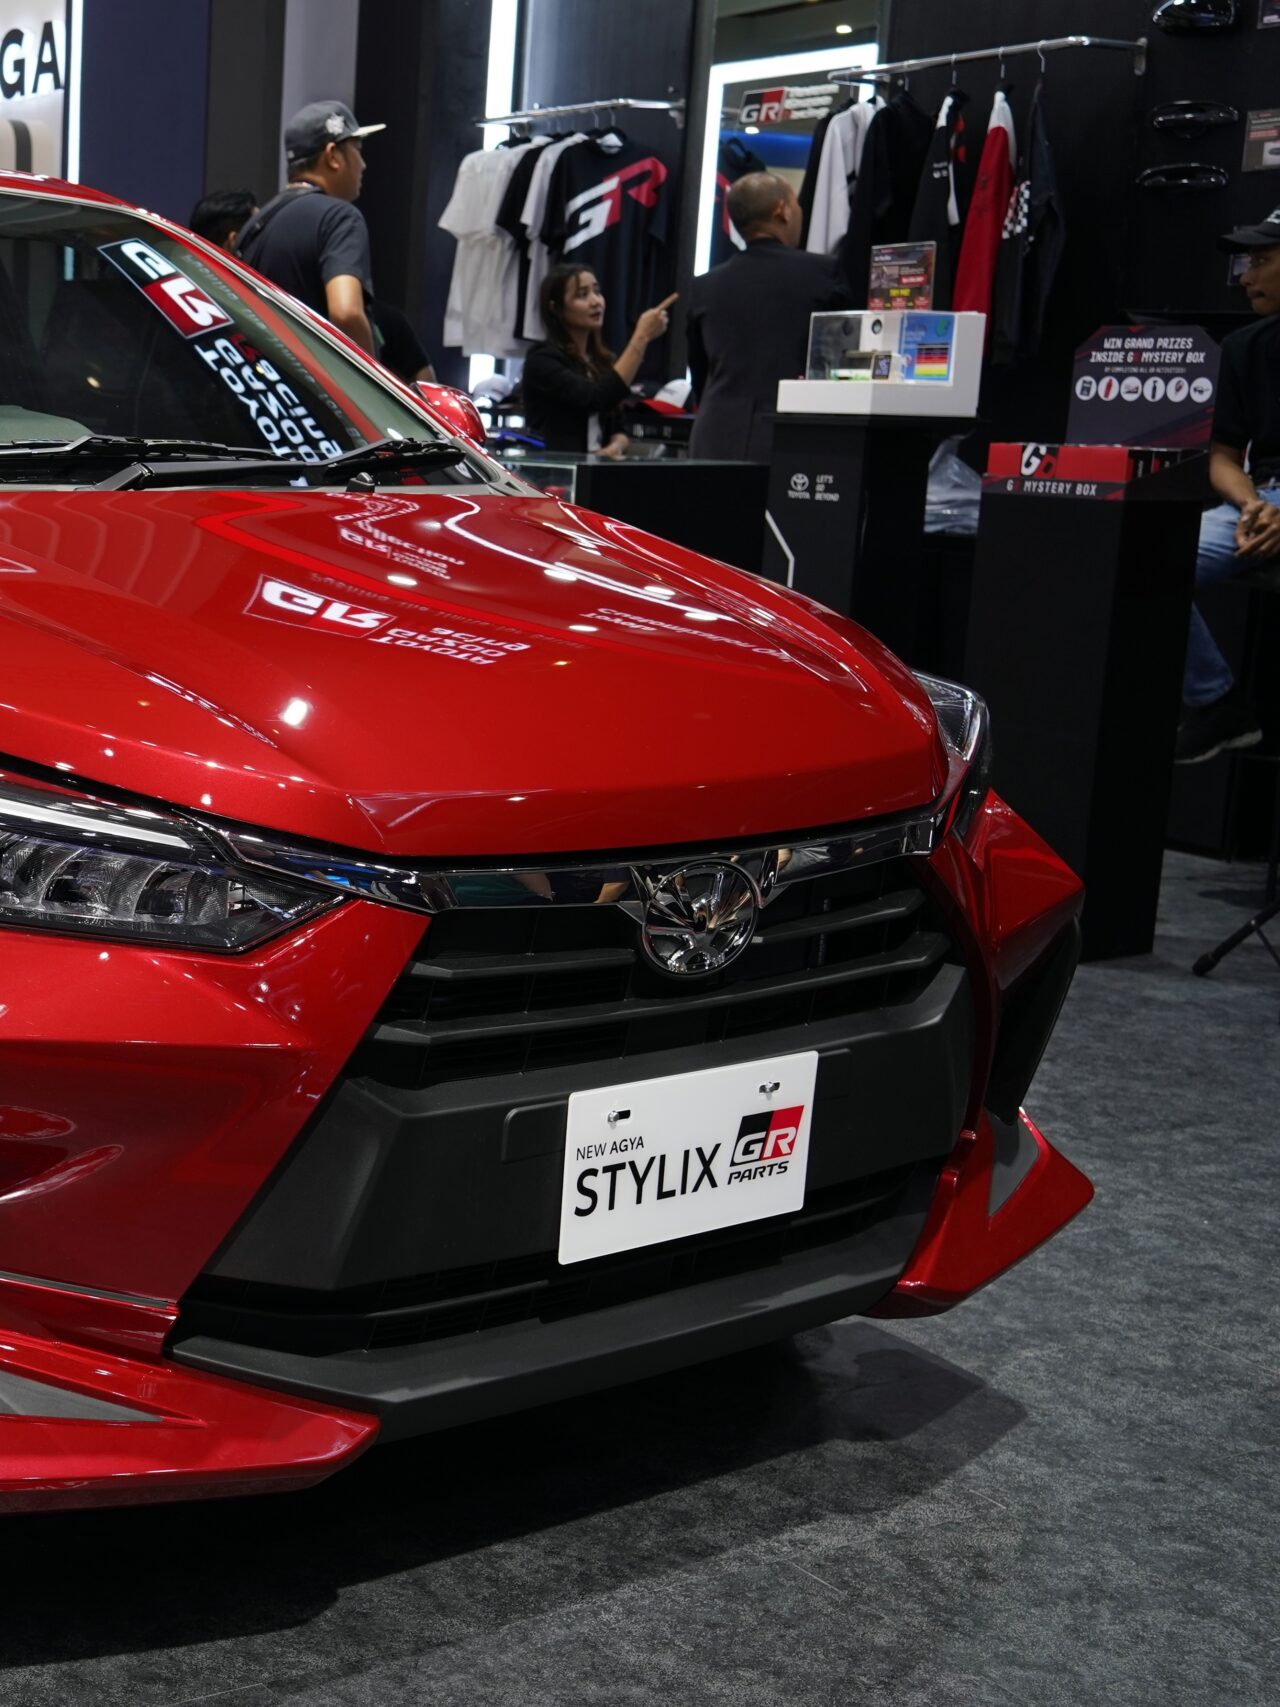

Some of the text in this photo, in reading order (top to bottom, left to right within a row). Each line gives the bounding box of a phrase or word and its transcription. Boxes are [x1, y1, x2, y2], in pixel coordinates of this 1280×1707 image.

[740, 102, 781, 124] GR
[563, 156, 668, 256] GR
[1103, 337, 1193, 349] WIN GRAND PRIZES
[1089, 351, 1124, 363] INSIDE
[1141, 351, 1184, 363] MYSTERY
[1185, 352, 1206, 363] BOX
[1023, 480, 1072, 494] MYSTERY
[1075, 483, 1098, 496] BOX
[576, 1136, 645, 1161] NEW AGYA
[731, 1126, 798, 1165] GR
[574, 1143, 723, 1217] STYLIX
[727, 1160, 790, 1186] PARTS
